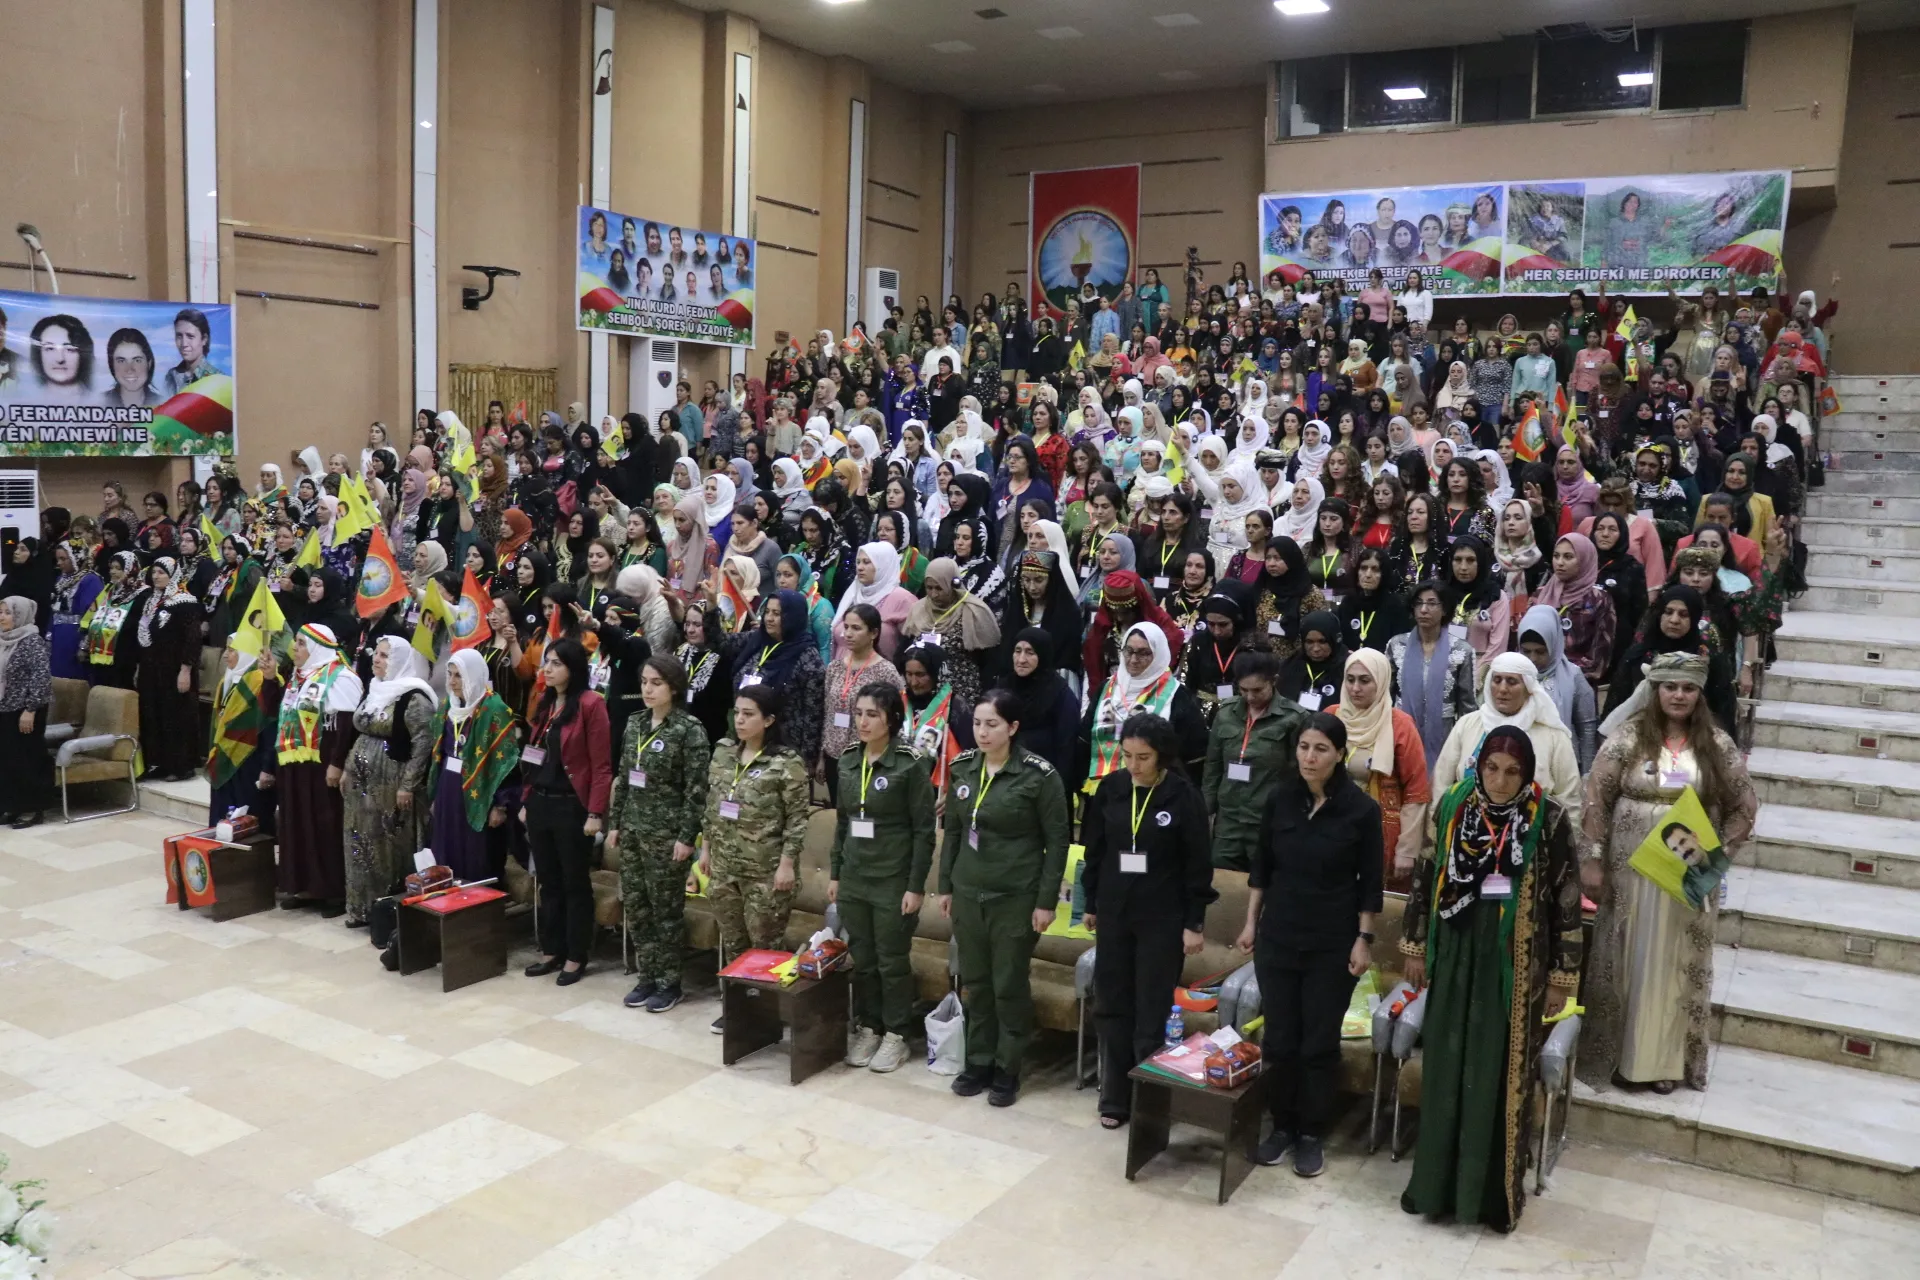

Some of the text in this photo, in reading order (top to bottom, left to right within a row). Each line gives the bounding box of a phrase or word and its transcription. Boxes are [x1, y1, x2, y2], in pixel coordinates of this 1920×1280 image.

[1358, 268, 1369, 279] BI
[1379, 267, 1407, 277] EREF
[1524, 268, 1552, 281] HER
[1628, 267, 1649, 281] ME
[1436, 279, 1452, 290] YE
[625, 297, 647, 312] JINA
[650, 300, 675, 315] KURD
[678, 304, 685, 316] A
[608, 312, 653, 328] SEMBOLA
[656, 317, 686, 334] ŞOREŞ
[688, 319, 695, 333] Û
[9, 404, 153, 422] FERMANDARÊN
[39, 423, 118, 443] MANEWÎ
[122, 426, 148, 443] NE
